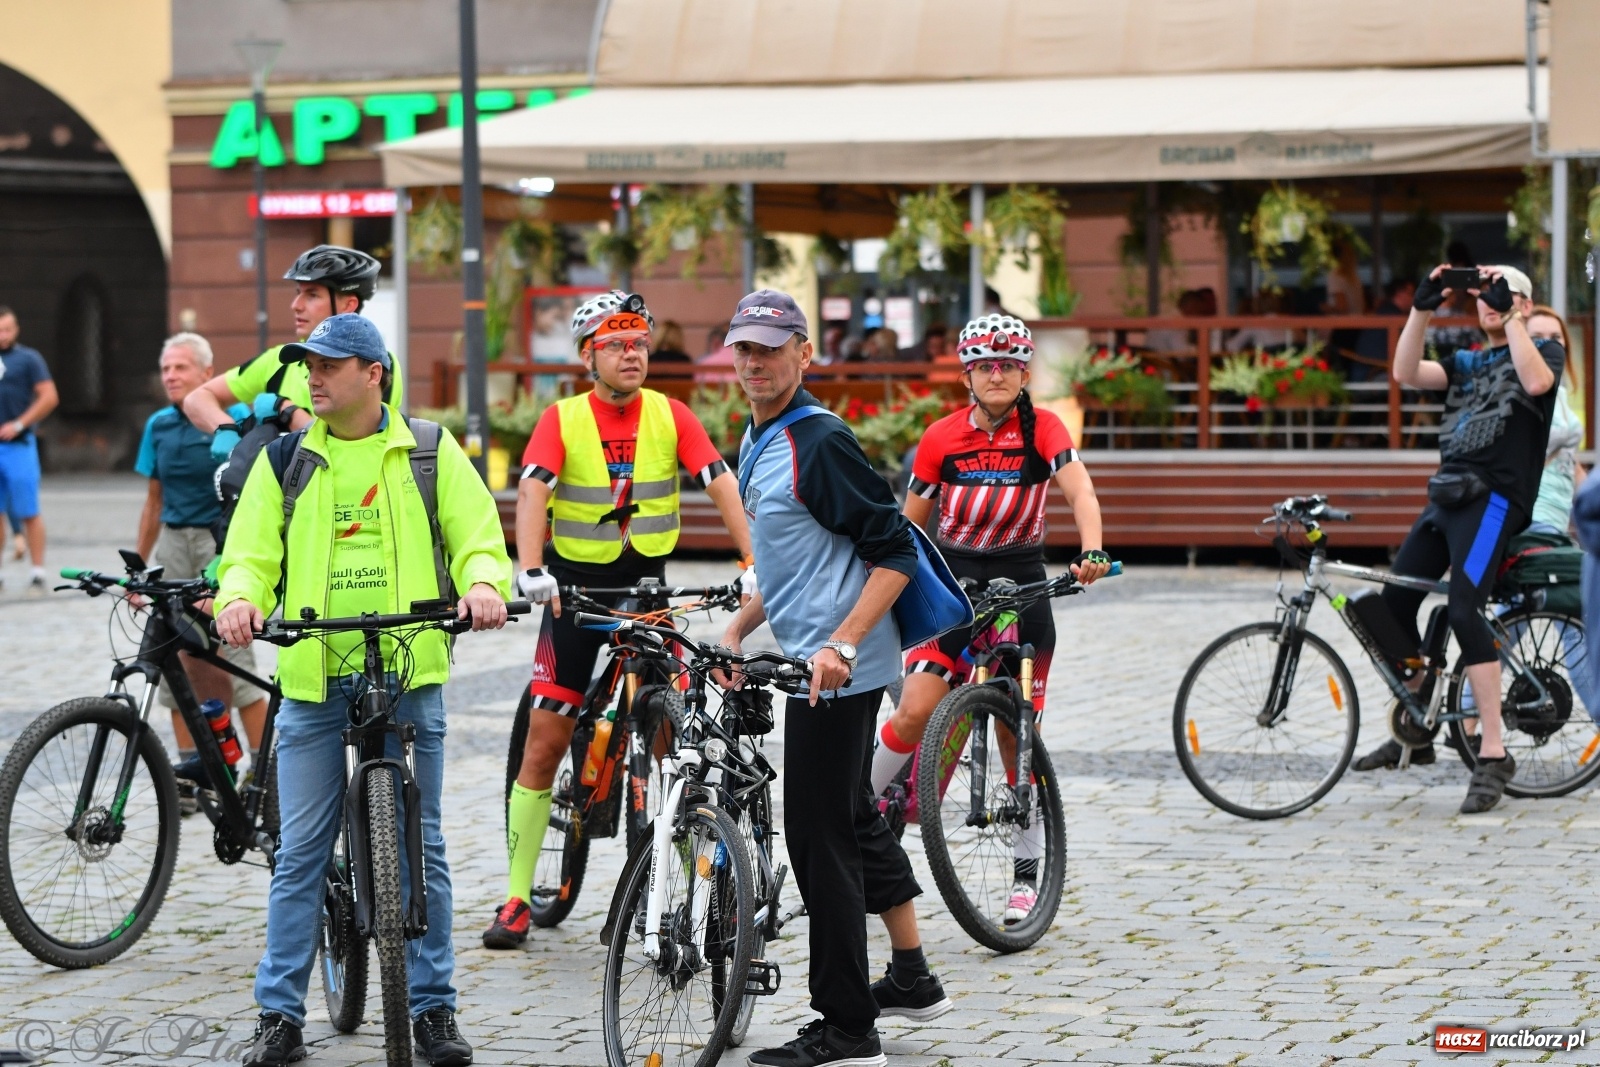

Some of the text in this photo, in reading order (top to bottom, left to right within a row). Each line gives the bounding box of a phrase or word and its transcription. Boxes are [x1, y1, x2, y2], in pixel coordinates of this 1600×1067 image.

[749, 306, 772, 315] TOP GUN
[607, 317, 640, 330] CCC
[954, 451, 1025, 472] RAFAKO
[957, 470, 1022, 479] ORBEA
[346, 580, 388, 590] Aramco
